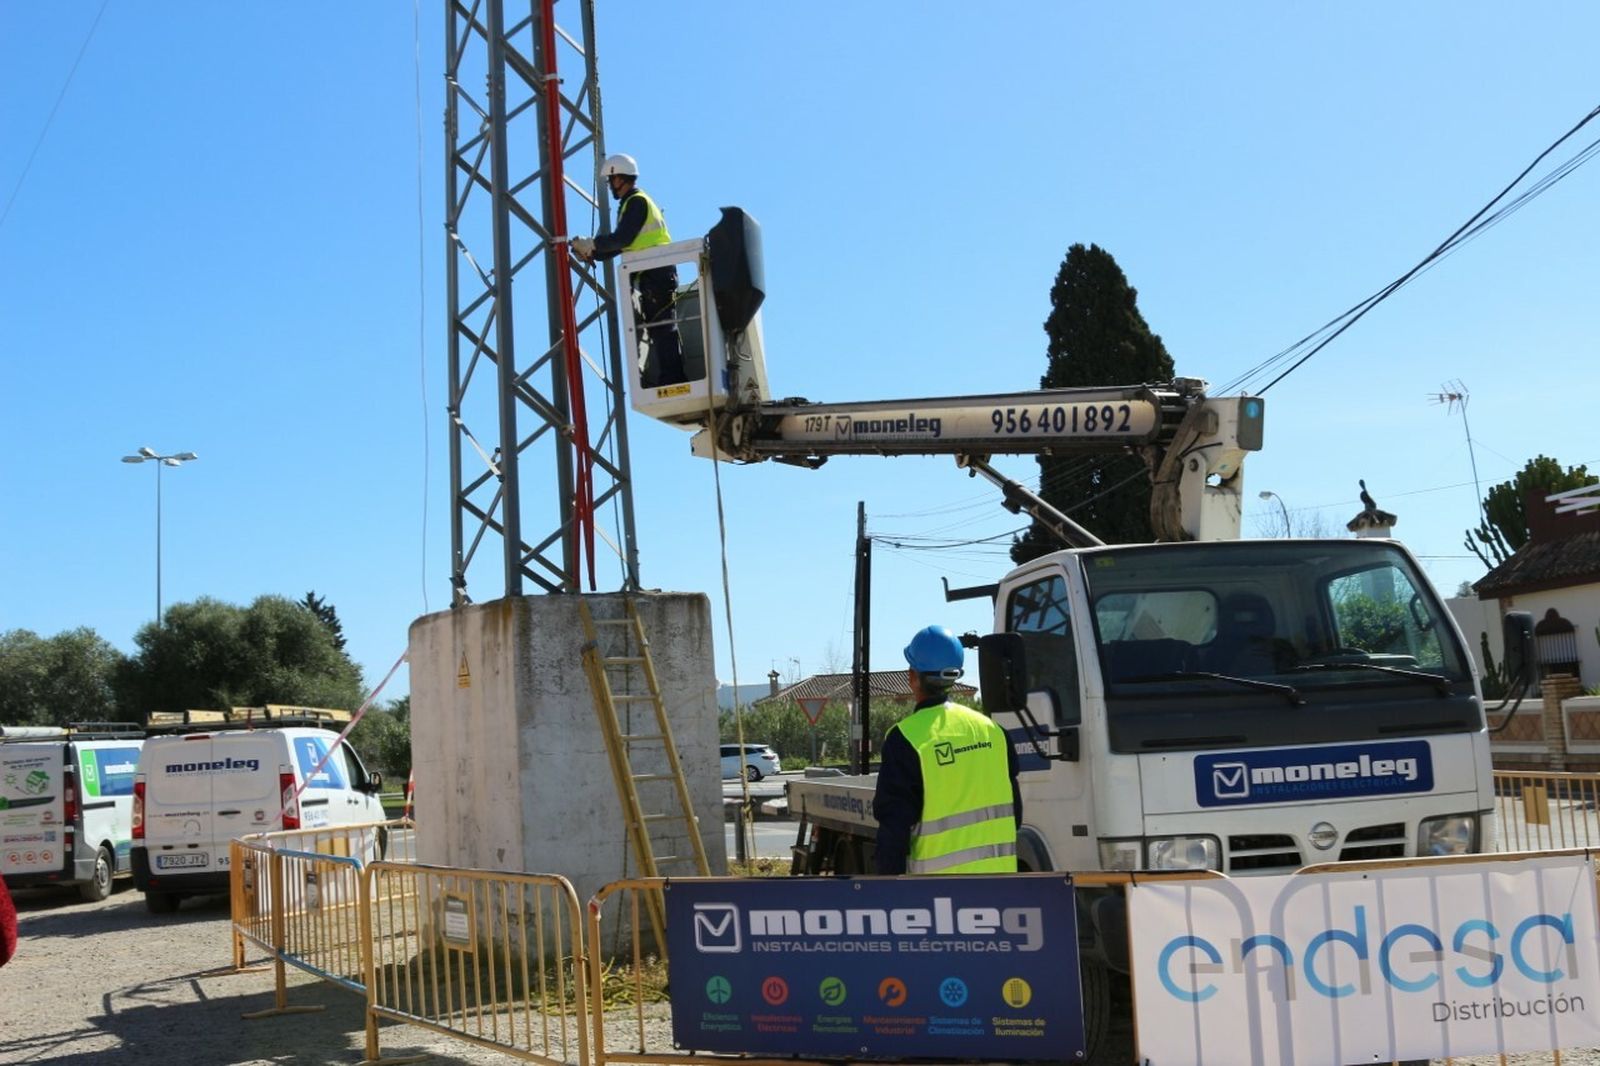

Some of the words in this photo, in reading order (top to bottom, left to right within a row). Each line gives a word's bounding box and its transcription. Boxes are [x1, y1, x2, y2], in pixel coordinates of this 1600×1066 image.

[853, 413, 942, 437] moneleg
[165, 757, 259, 772] moneleg
[1251, 755, 1418, 784] moneleg
[749, 897, 1044, 951] moneleg
[752, 941, 892, 952] INSTALACIONES
[898, 938, 1011, 952] ELÉCTRICAS
[1157, 905, 1579, 1003] endesa
[1431, 992, 1585, 1022] Distribución
[928, 1016, 970, 1025] Sistemas
[971, 1016, 982, 1025] de
[991, 1016, 1033, 1027] Sistemas
[1035, 1017, 1046, 1026] de
[995, 1027, 1045, 1037] Iluminación
